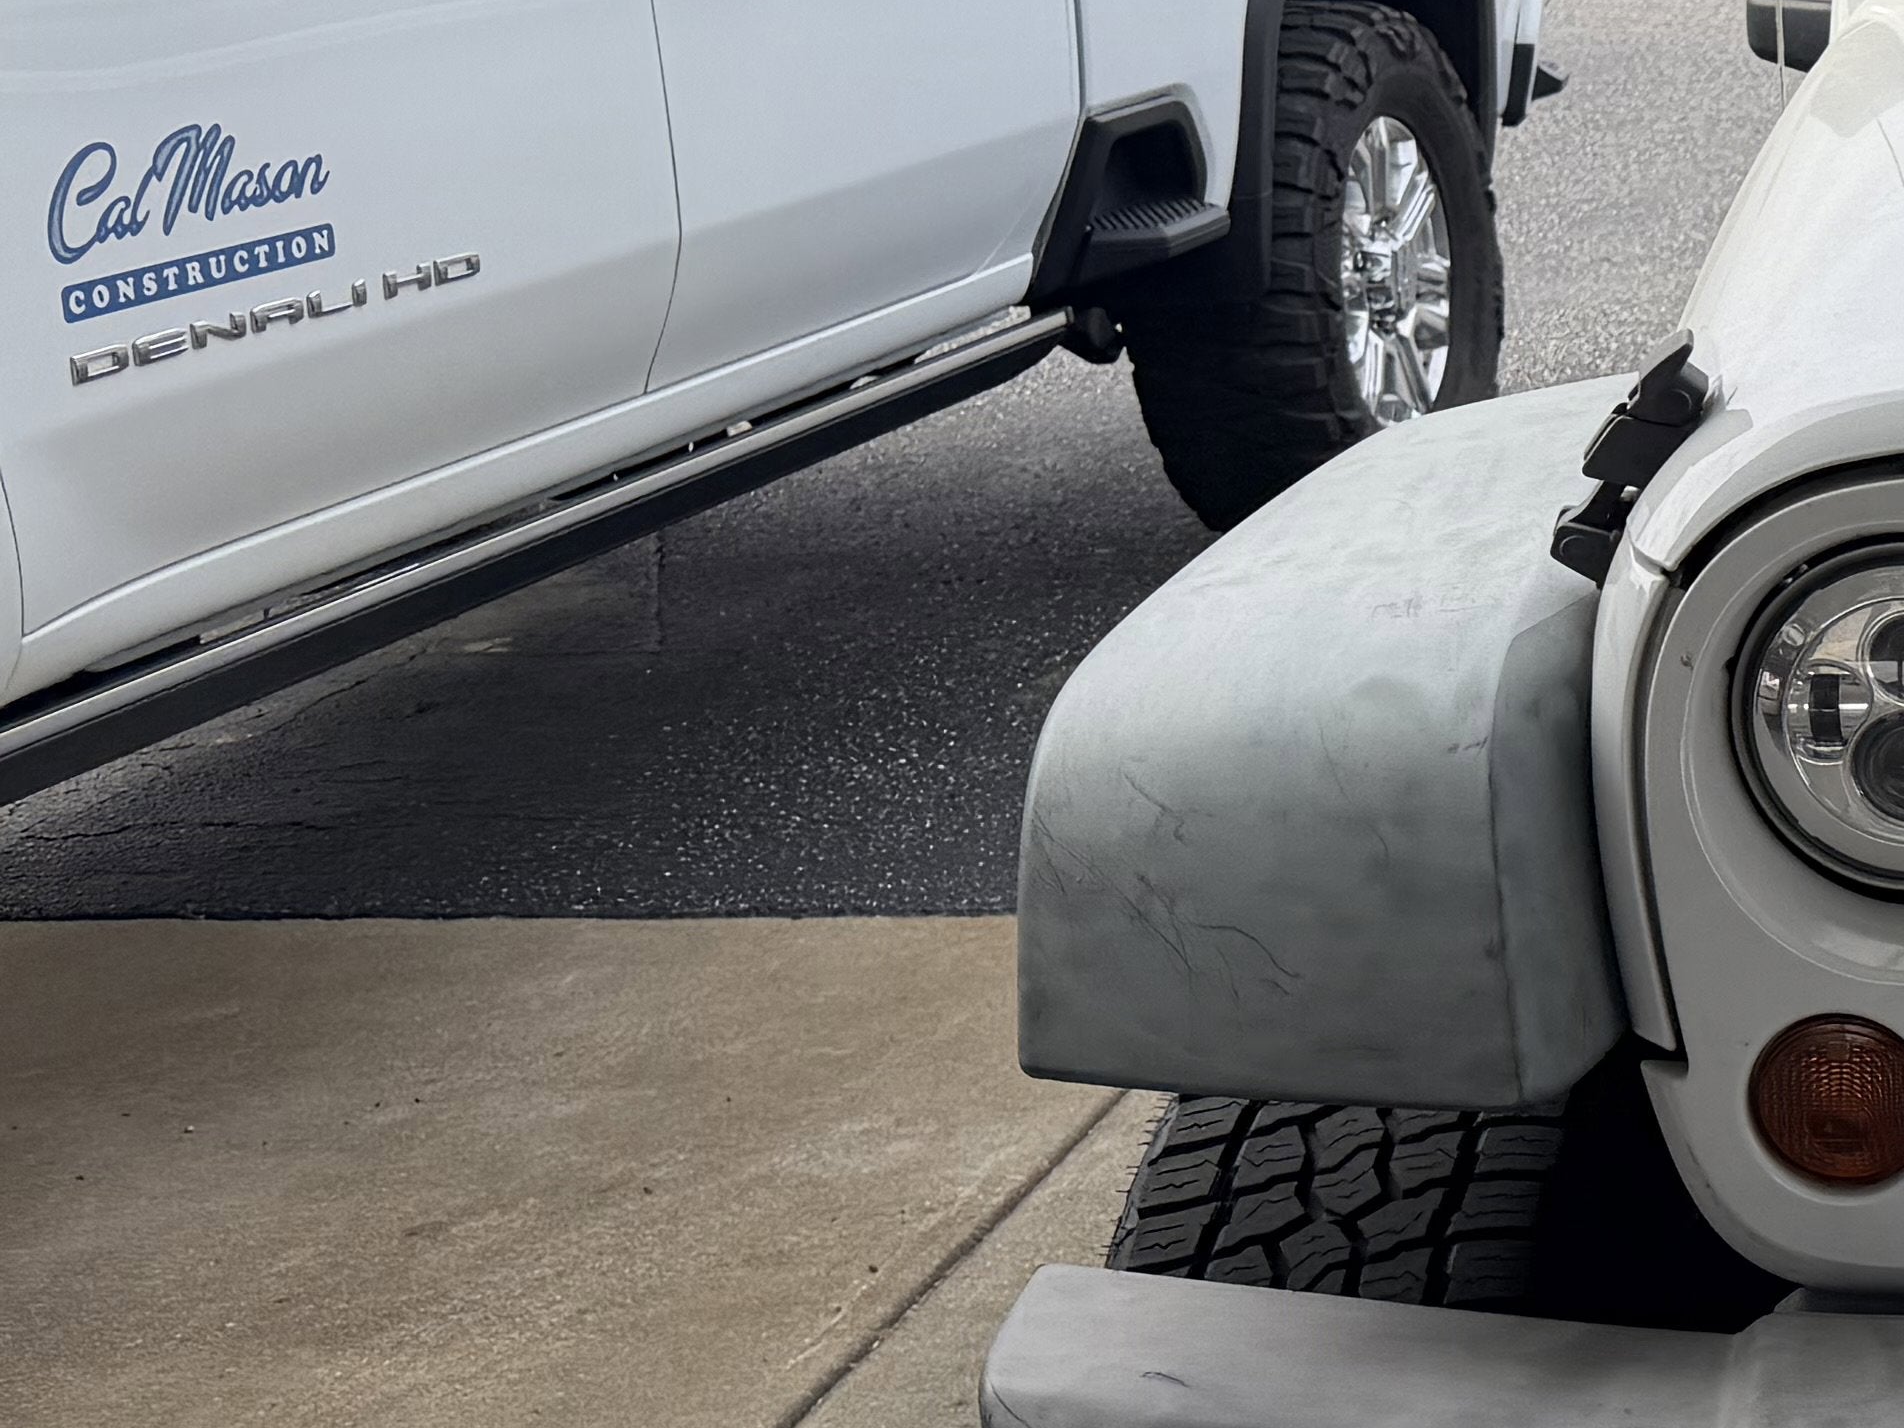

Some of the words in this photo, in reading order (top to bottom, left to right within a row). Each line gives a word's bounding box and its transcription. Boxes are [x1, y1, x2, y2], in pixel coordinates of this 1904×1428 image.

[48, 141, 152, 265] Cal
[150, 123, 331, 236] Mason
[68, 229, 332, 316] CONSTRUCTION
[69, 278, 368, 387] DENALI
[382, 251, 482, 301] HD
